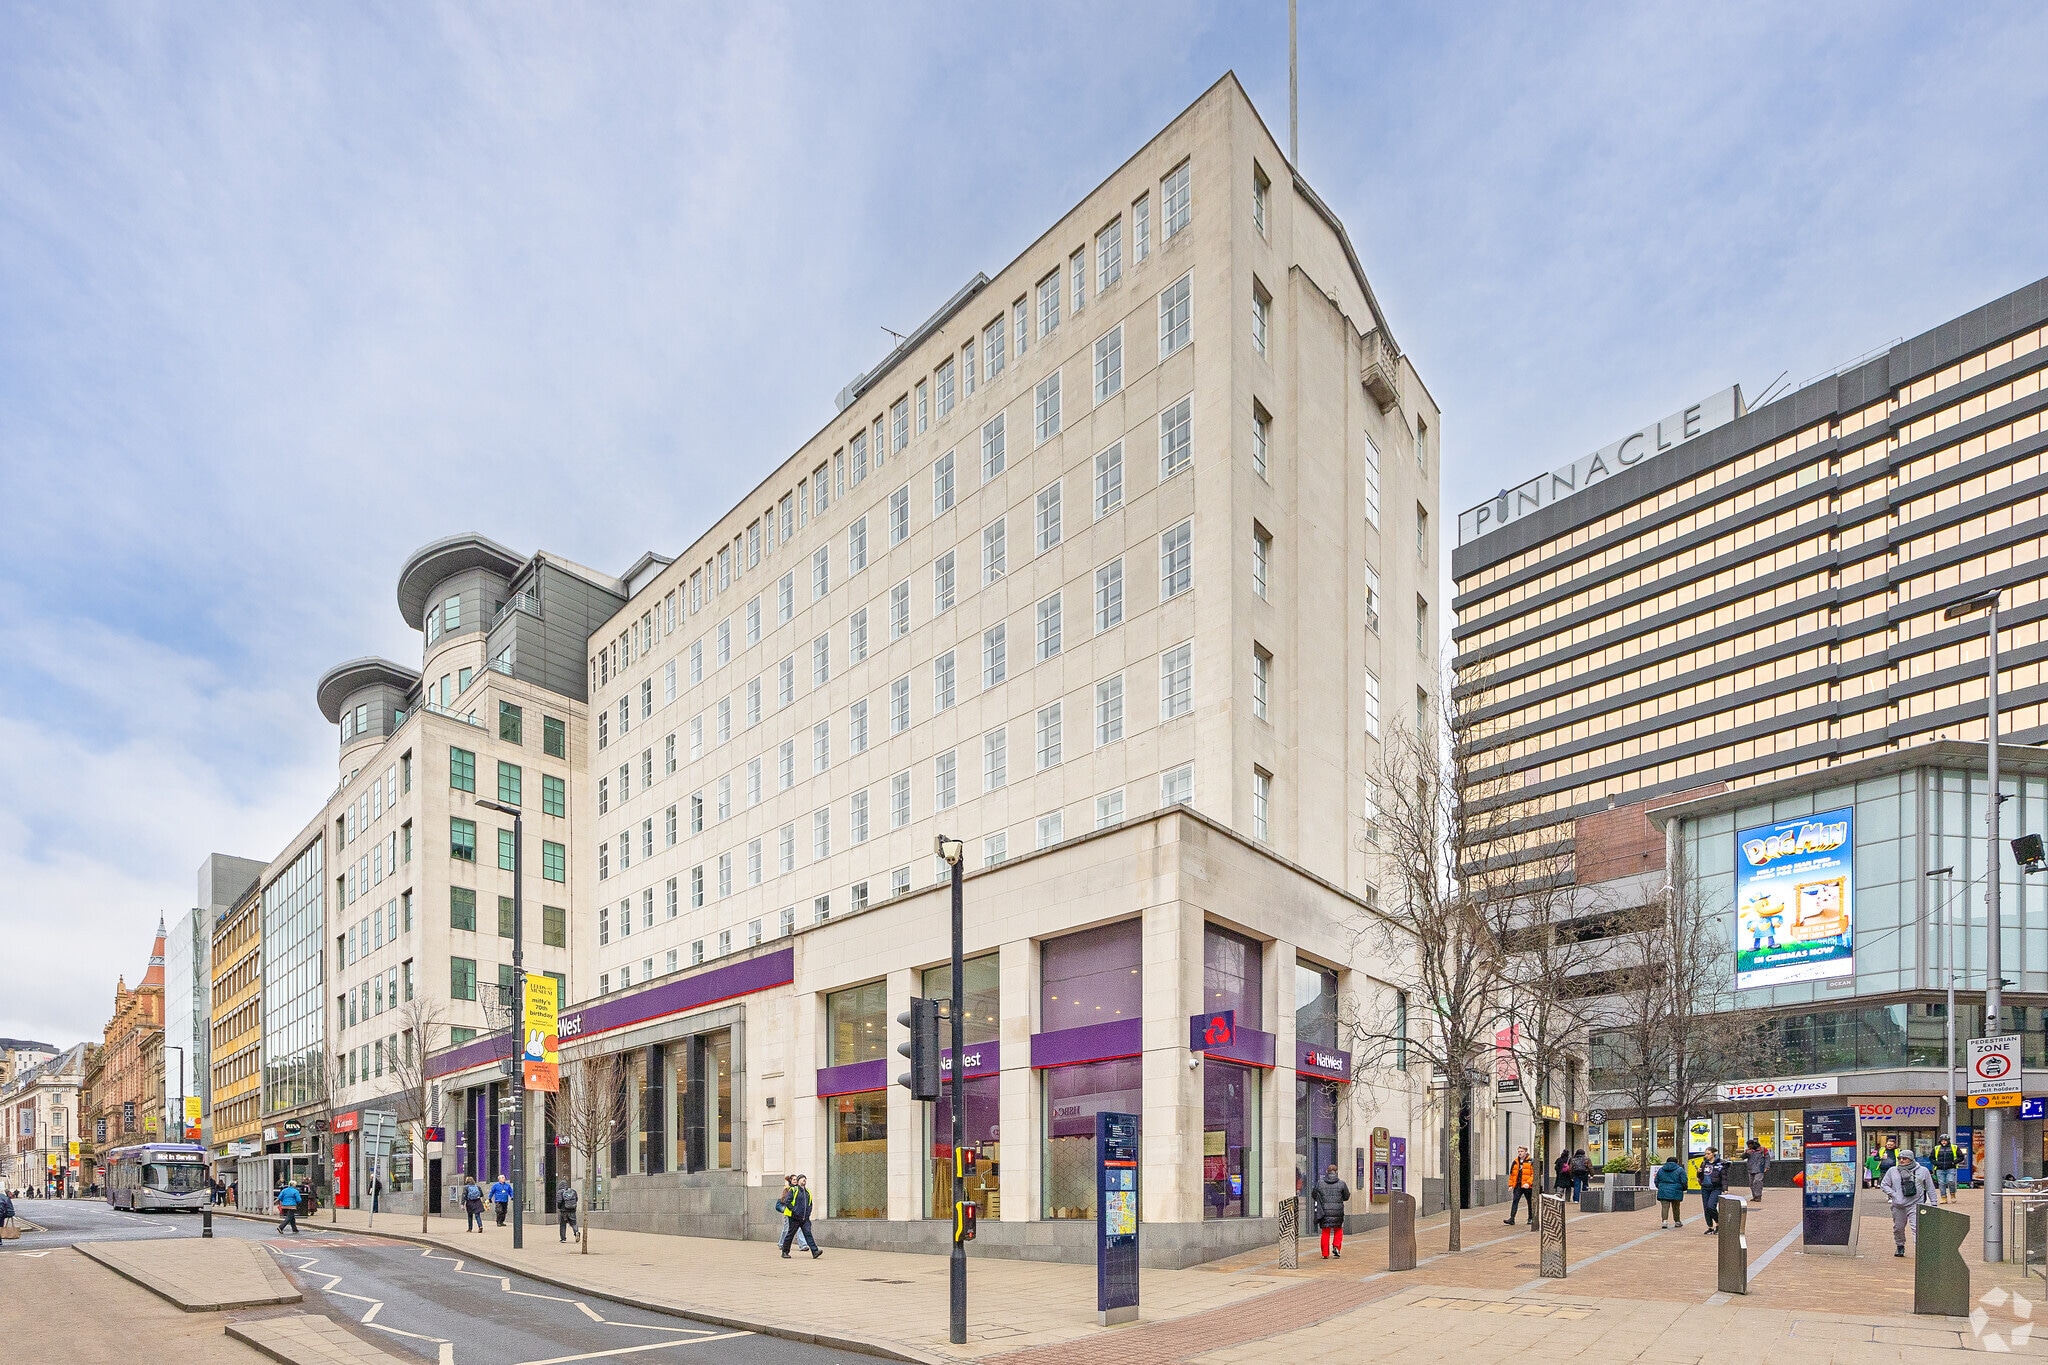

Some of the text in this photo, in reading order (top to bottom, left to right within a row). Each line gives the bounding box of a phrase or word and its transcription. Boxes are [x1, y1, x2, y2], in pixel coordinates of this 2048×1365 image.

[1476, 404, 1701, 535] PINNACLE
[1742, 821, 1847, 866] DOG MAN
[1753, 946, 1835, 964] IN CINEMAS NOW
[531, 998, 551, 1006] miffy's
[529, 1010, 554, 1019] birthday
[557, 1014, 582, 1038] West
[1970, 1037, 2017, 1045] PEDESTRIAN
[1977, 1044, 2010, 1053] ZONE
[941, 1051, 981, 1070] Naest
[1316, 1052, 1343, 1071] NatWest
[1726, 1081, 1828, 1095] TESCO express
[1895, 1104, 1936, 1115] express
[2022, 1102, 2031, 1113] P
